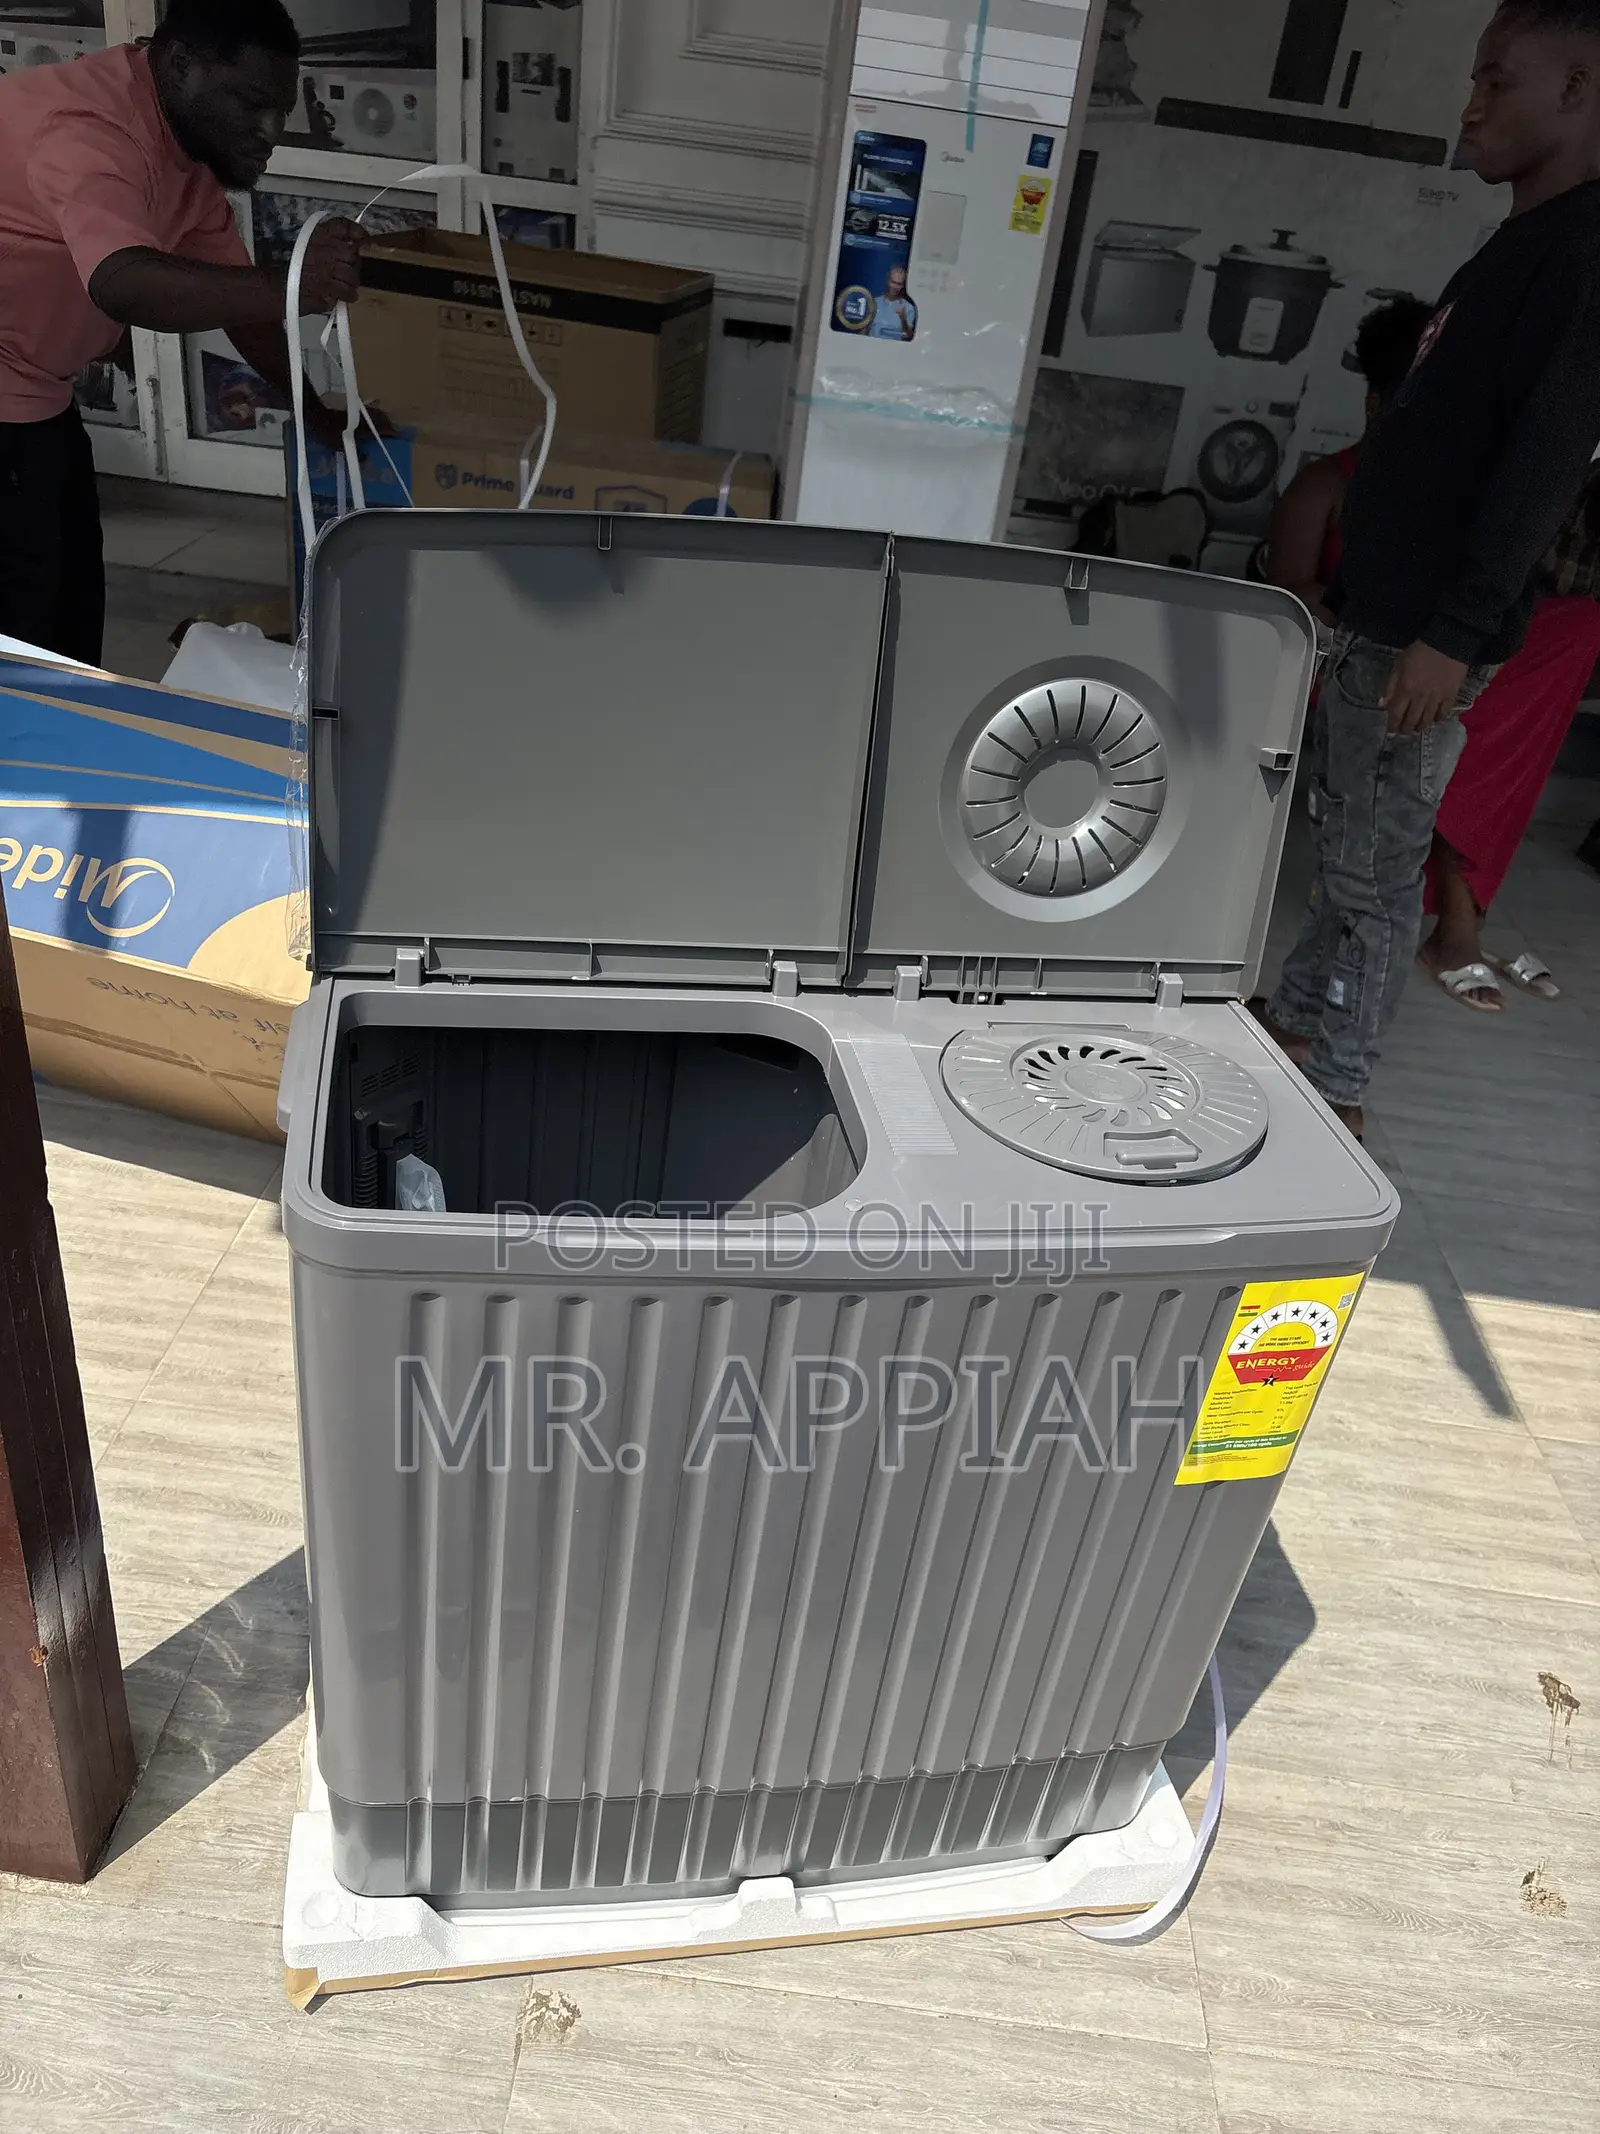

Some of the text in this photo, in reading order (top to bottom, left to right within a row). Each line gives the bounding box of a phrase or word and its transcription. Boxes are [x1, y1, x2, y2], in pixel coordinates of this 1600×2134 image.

[877, 219, 908, 234] 12.5X
[461, 471, 515, 493] Prime
[86, 976, 197, 1016] home
[199, 1004, 241, 1024] at
[1236, 1356, 1300, 1370] ENERGY
[1292, 1361, 1315, 1372] guide
